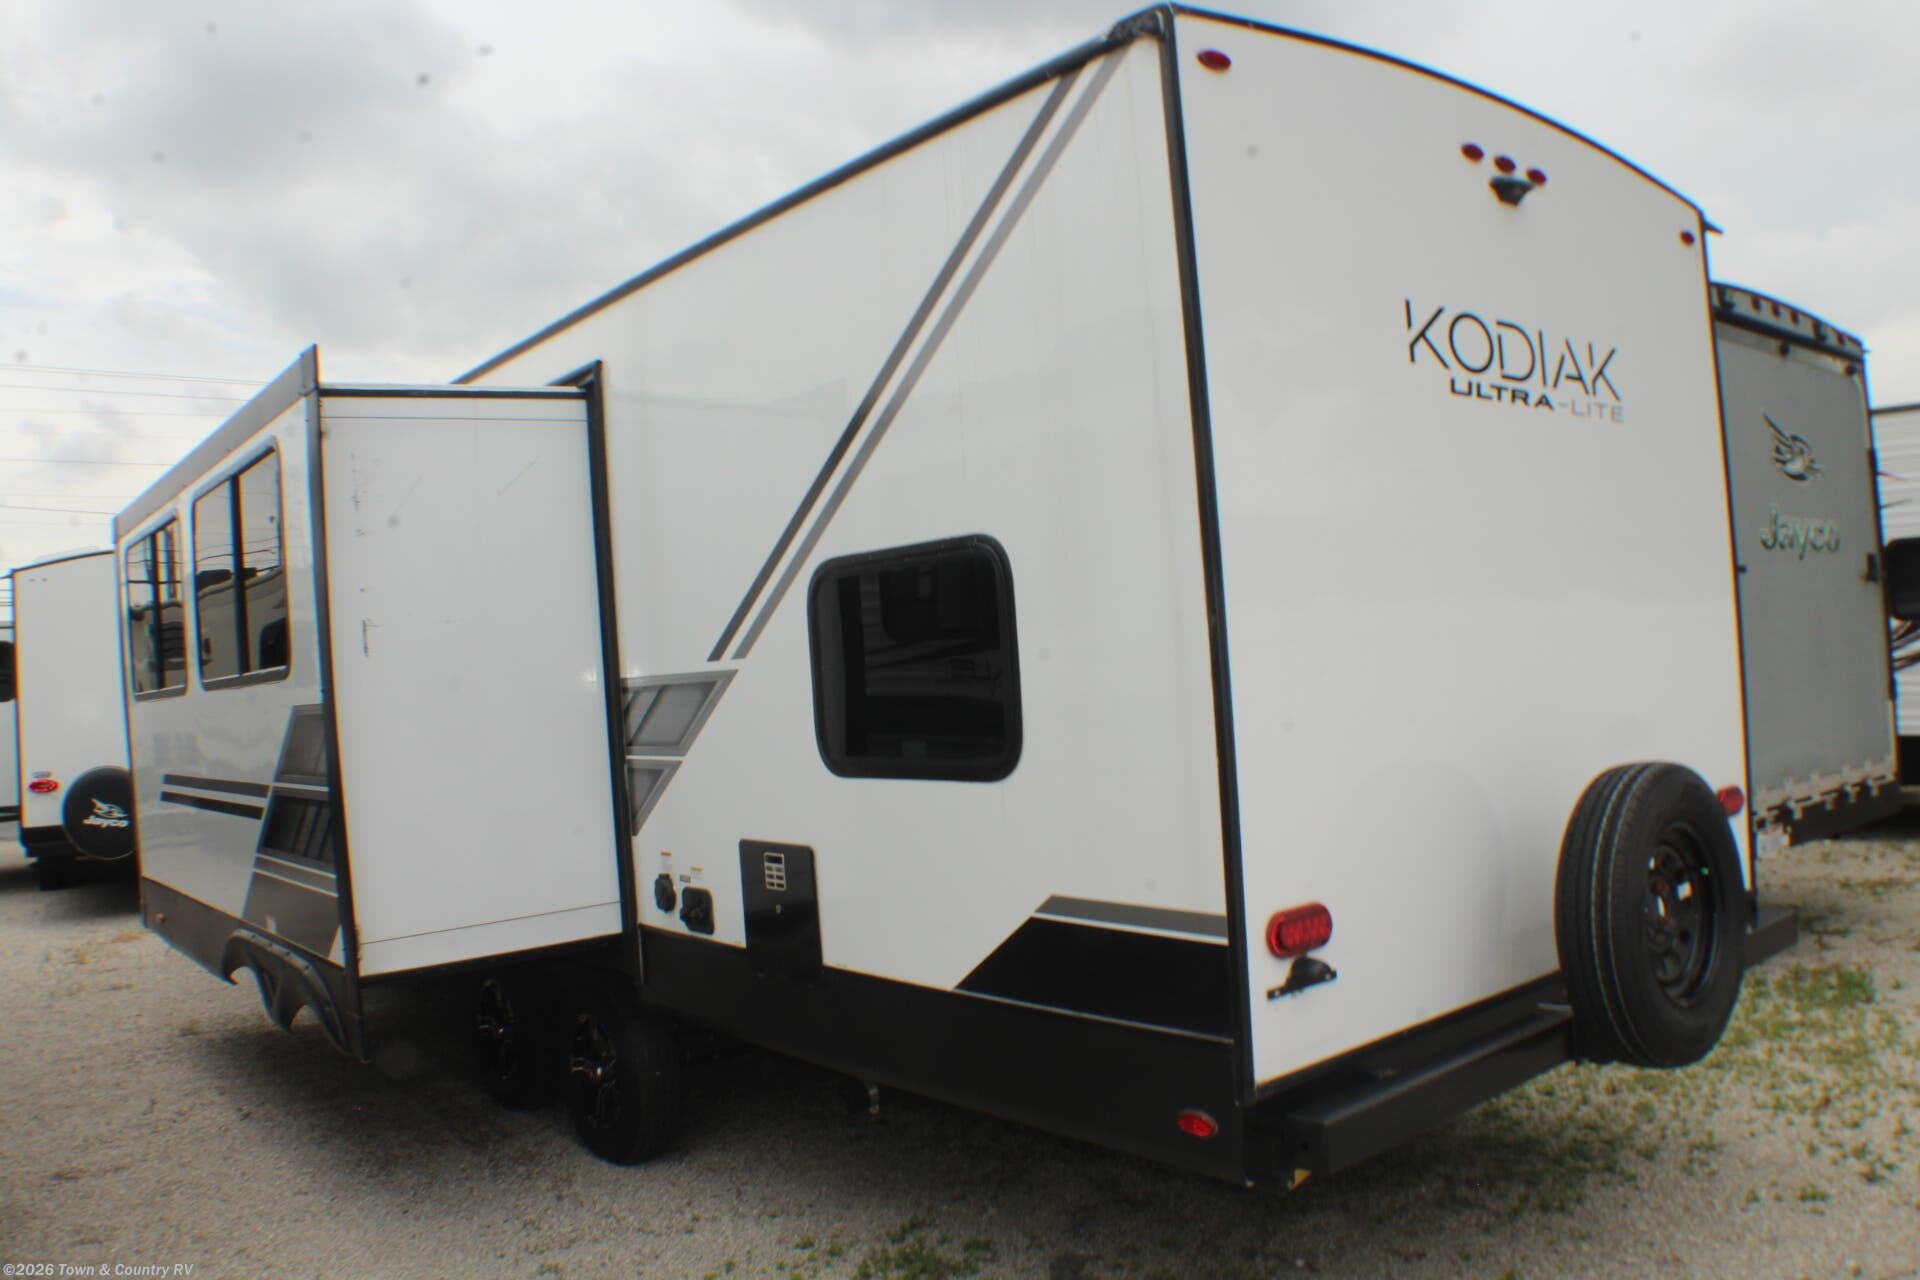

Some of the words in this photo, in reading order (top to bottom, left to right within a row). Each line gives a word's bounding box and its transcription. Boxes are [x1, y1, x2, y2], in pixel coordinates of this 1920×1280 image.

[1404, 298, 1622, 402] KODIAK
[1450, 378, 1625, 424] ULTRA-LITE
[1760, 503, 1841, 560] Jayco
[82, 815, 130, 828] Jayco
